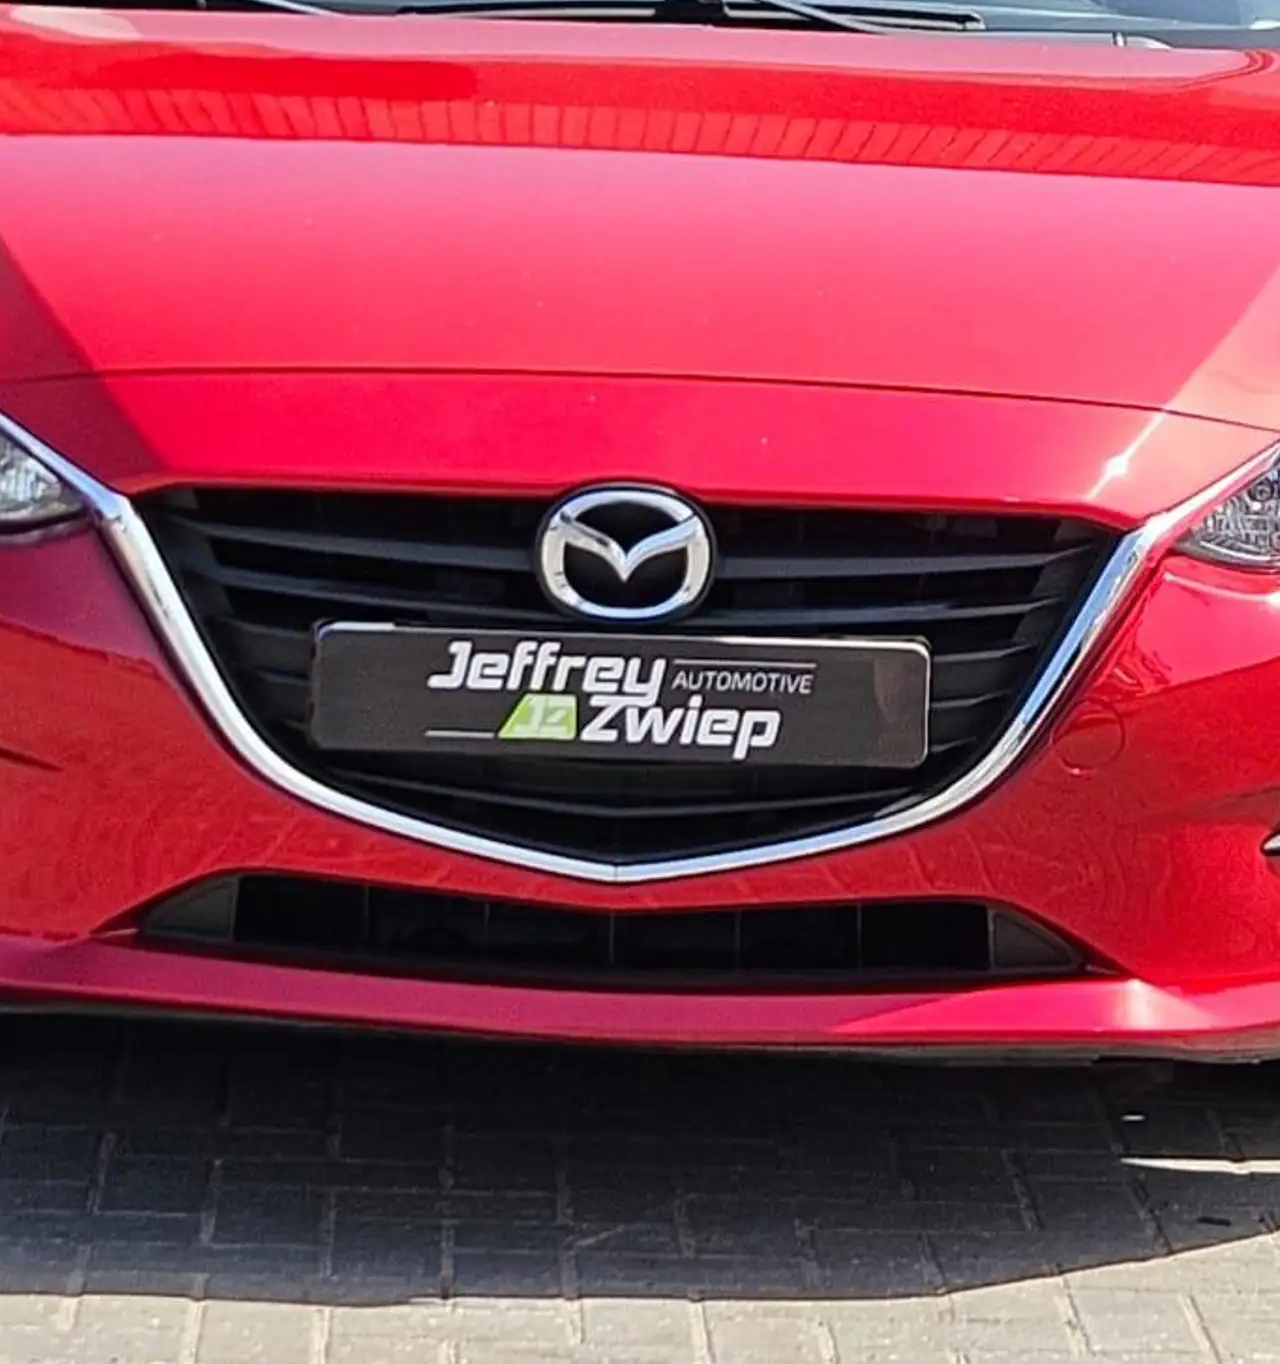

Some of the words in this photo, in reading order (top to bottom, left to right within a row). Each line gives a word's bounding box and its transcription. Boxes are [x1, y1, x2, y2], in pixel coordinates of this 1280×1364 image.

[427, 640, 667, 707] Jeffrey
[671, 668, 814, 695] AUTOMOTIVE
[580, 696, 781, 761] Zwiep
